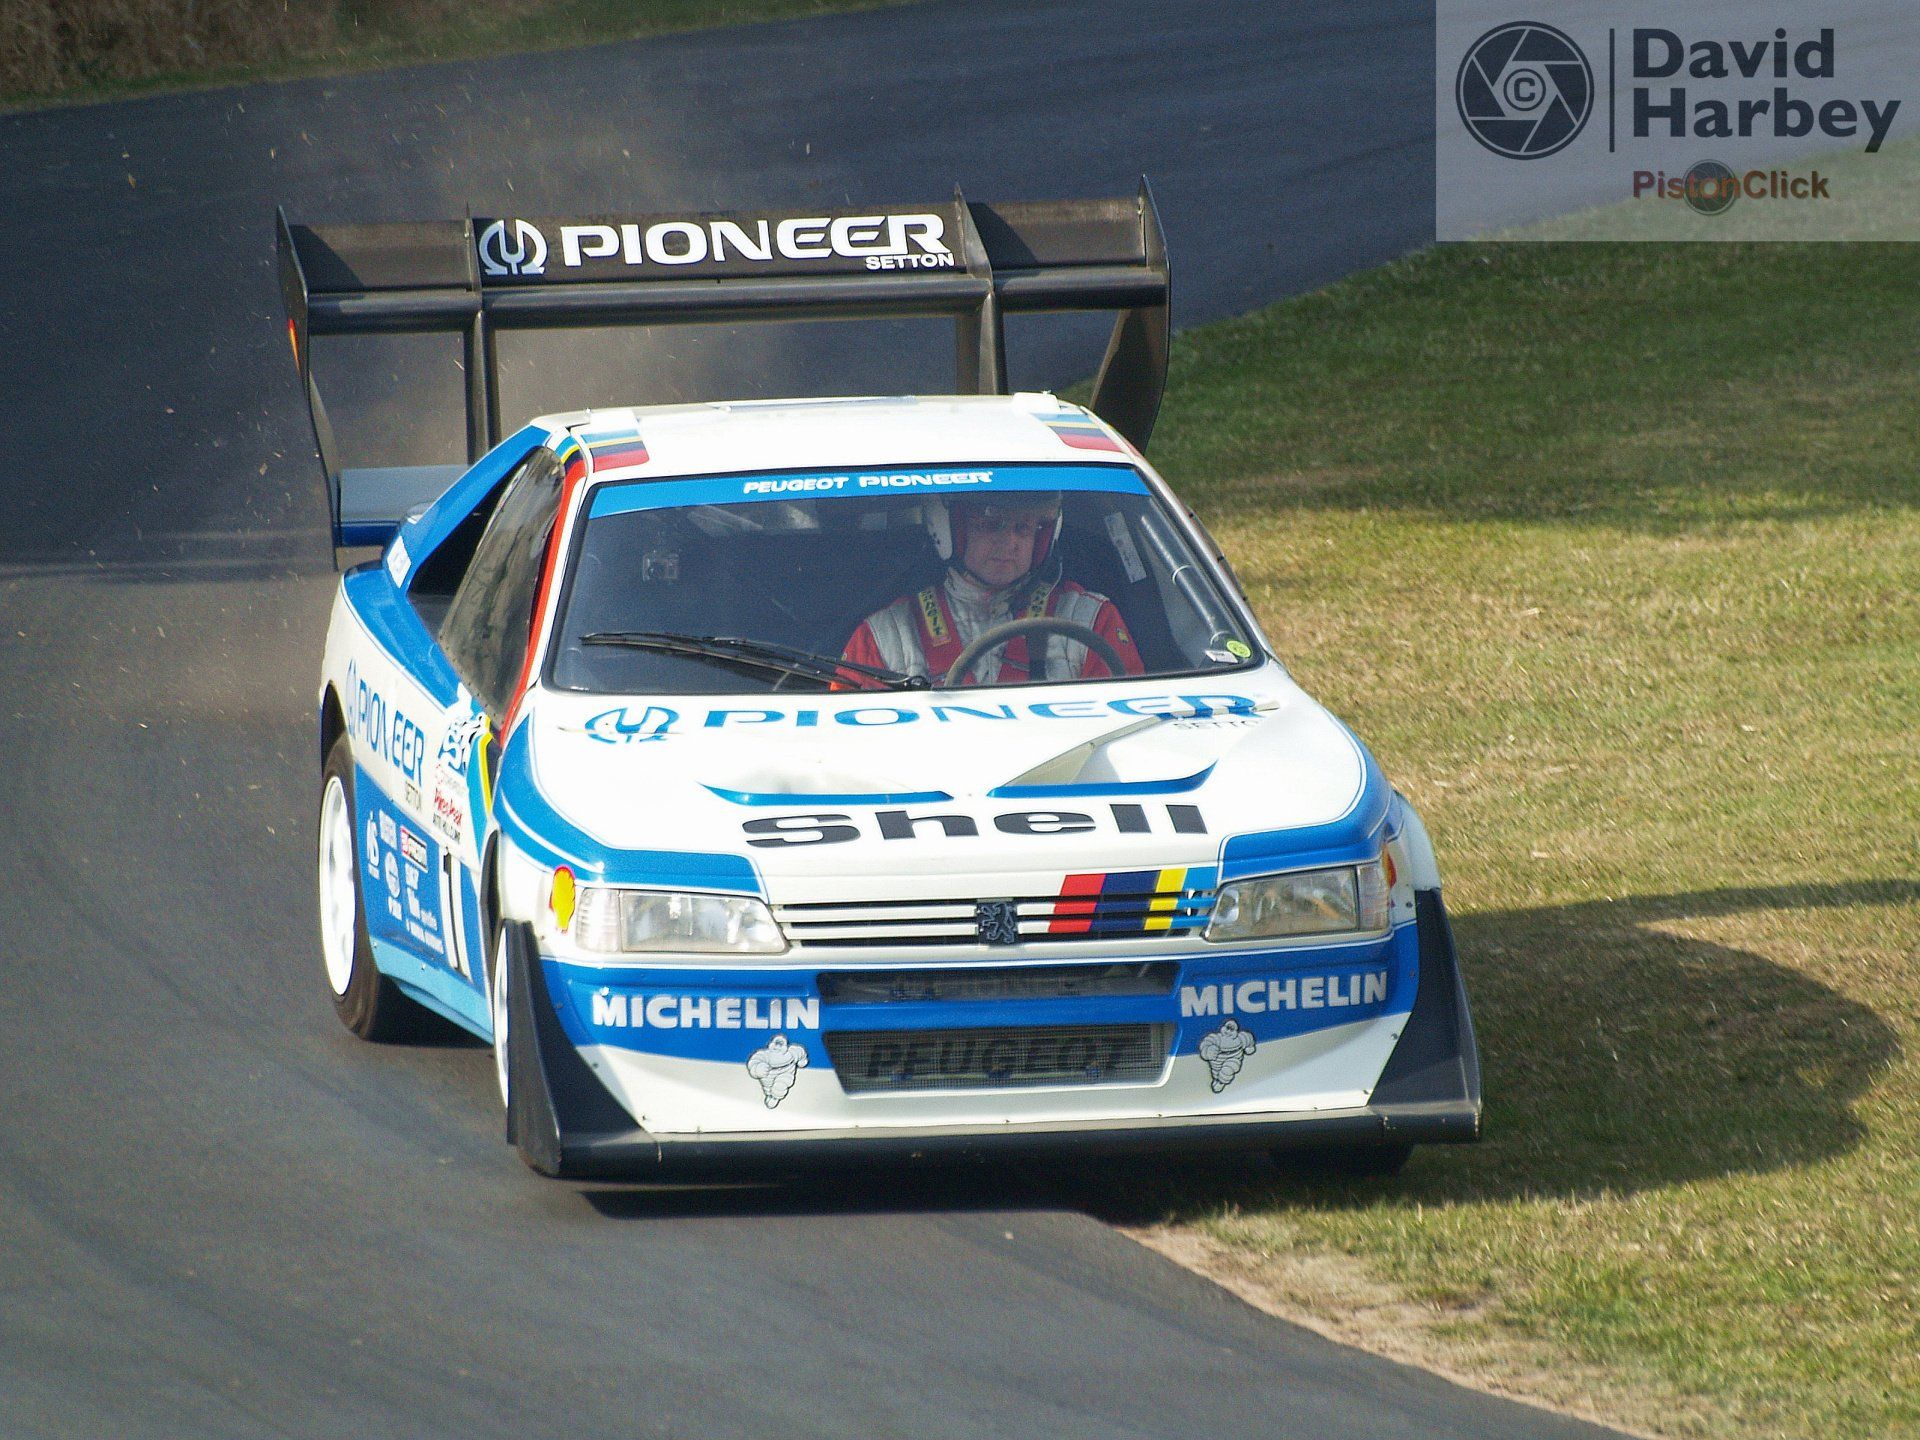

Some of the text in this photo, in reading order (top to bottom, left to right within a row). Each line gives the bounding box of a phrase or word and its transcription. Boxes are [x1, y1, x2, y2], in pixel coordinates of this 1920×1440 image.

[560, 213, 951, 267] PIONEER
[866, 252, 955, 270] SETTON
[743, 471, 994, 494] PEUGEOT PIONEER
[703, 694, 1264, 728] PIONEER
[358, 679, 425, 788] PIONEER
[742, 803, 1209, 848] Shell
[592, 994, 820, 1030] MICHELIN
[1180, 970, 1388, 1018] MICHELIN
[867, 1037, 1132, 1078] PEUGEOT
